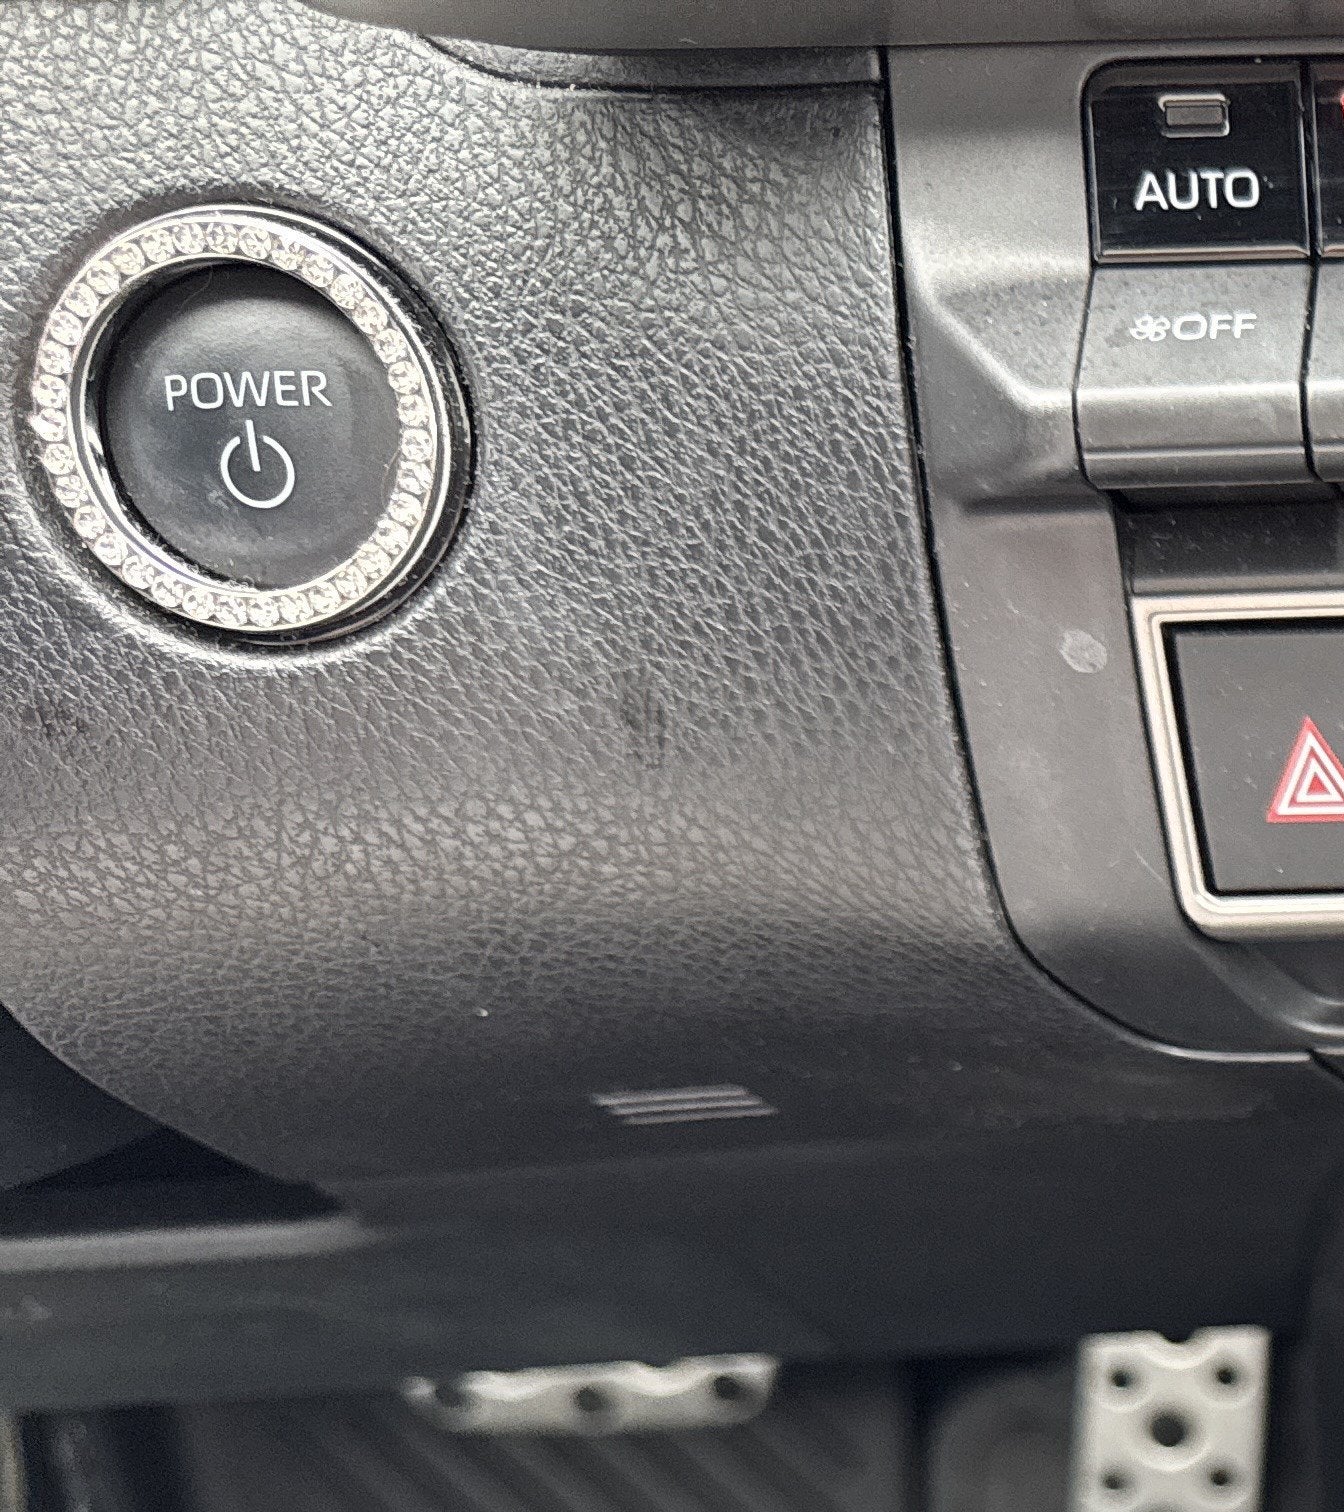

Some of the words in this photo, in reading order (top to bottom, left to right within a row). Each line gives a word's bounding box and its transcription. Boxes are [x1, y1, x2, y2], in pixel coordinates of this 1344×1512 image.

[1134, 169, 1260, 211] AUTO
[1171, 313, 1258, 342] OFF
[164, 369, 333, 412] POWER
